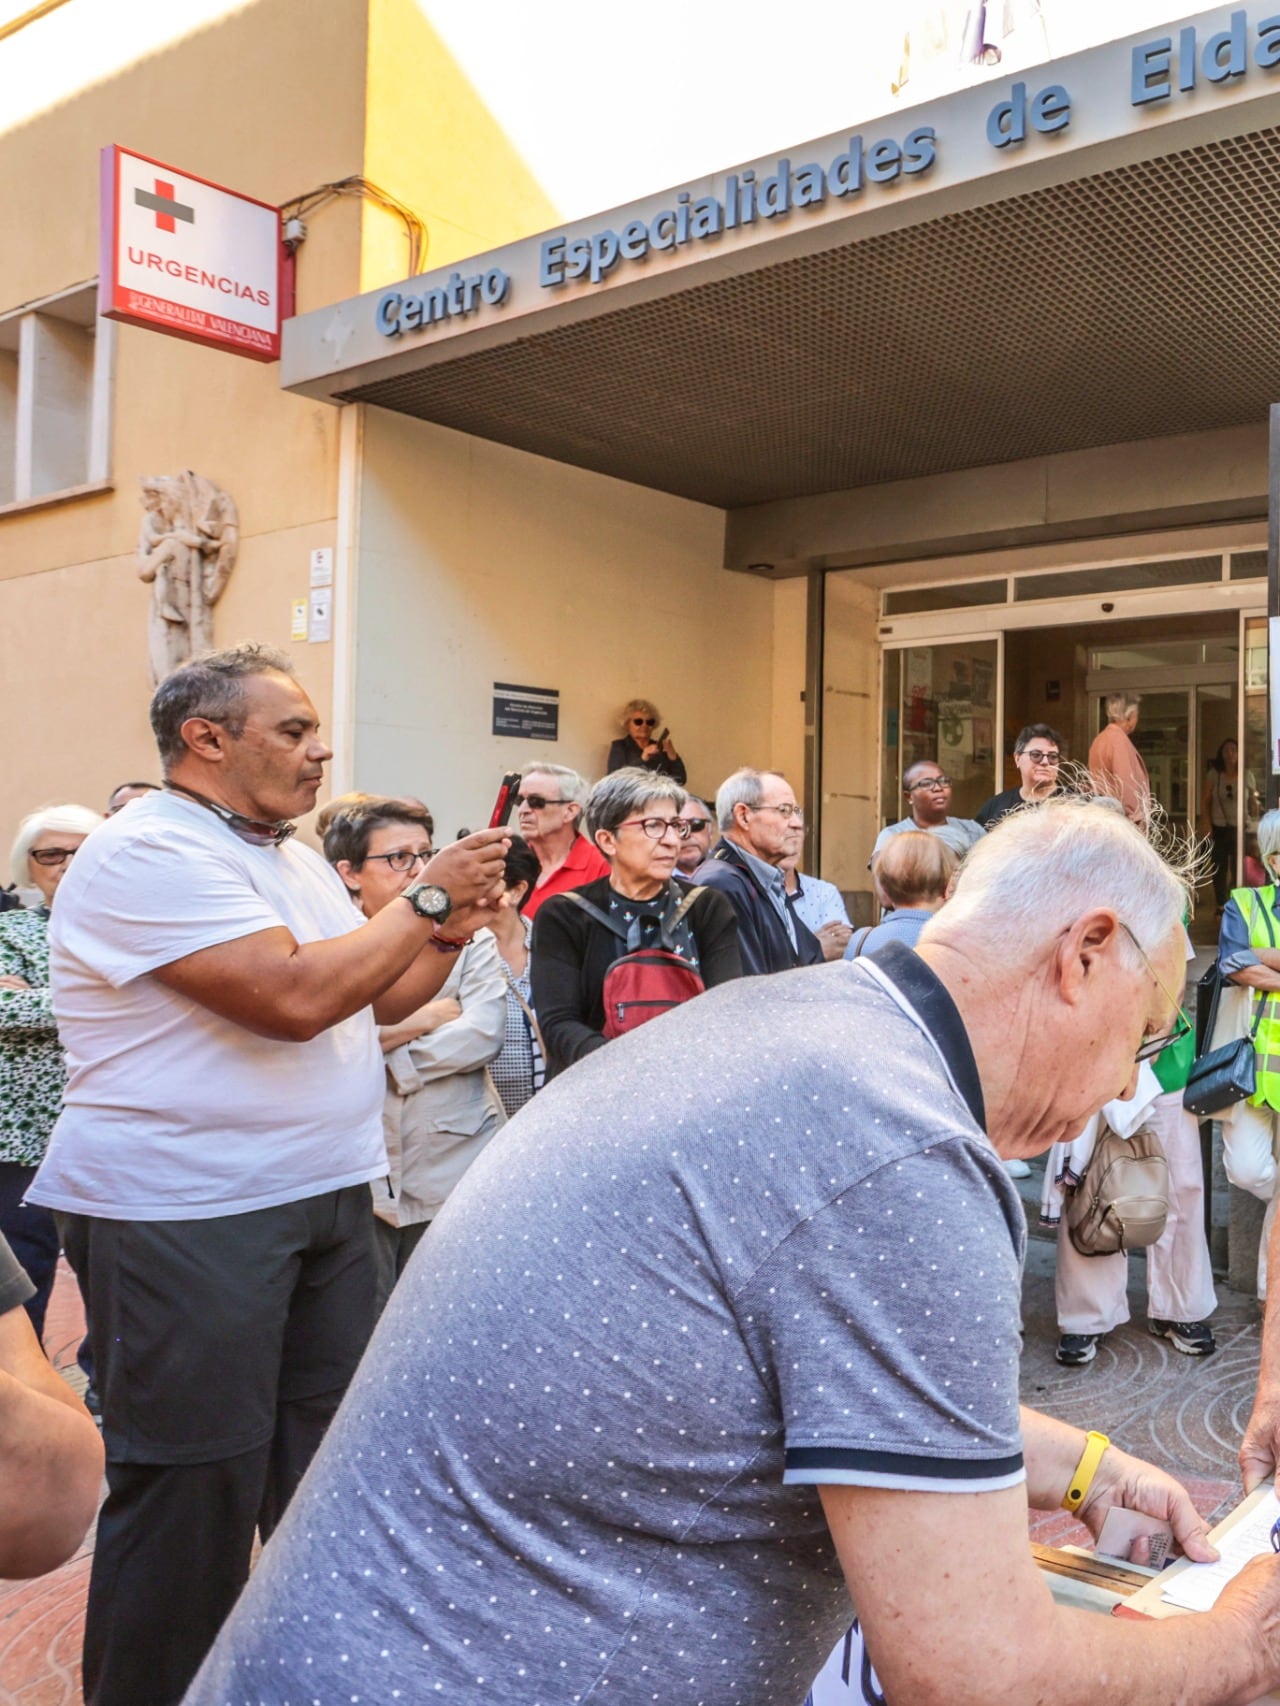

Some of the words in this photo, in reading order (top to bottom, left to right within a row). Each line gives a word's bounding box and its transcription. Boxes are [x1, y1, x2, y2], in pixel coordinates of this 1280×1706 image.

[375, 265, 508, 338] Centro
[538, 125, 937, 288] Especialidades
[986, 82, 1071, 148] de
[128, 246, 270, 306] URGENCIAS
[142, 296, 206, 327] GENERALITAT
[210, 317, 272, 346] VALENCIANA
